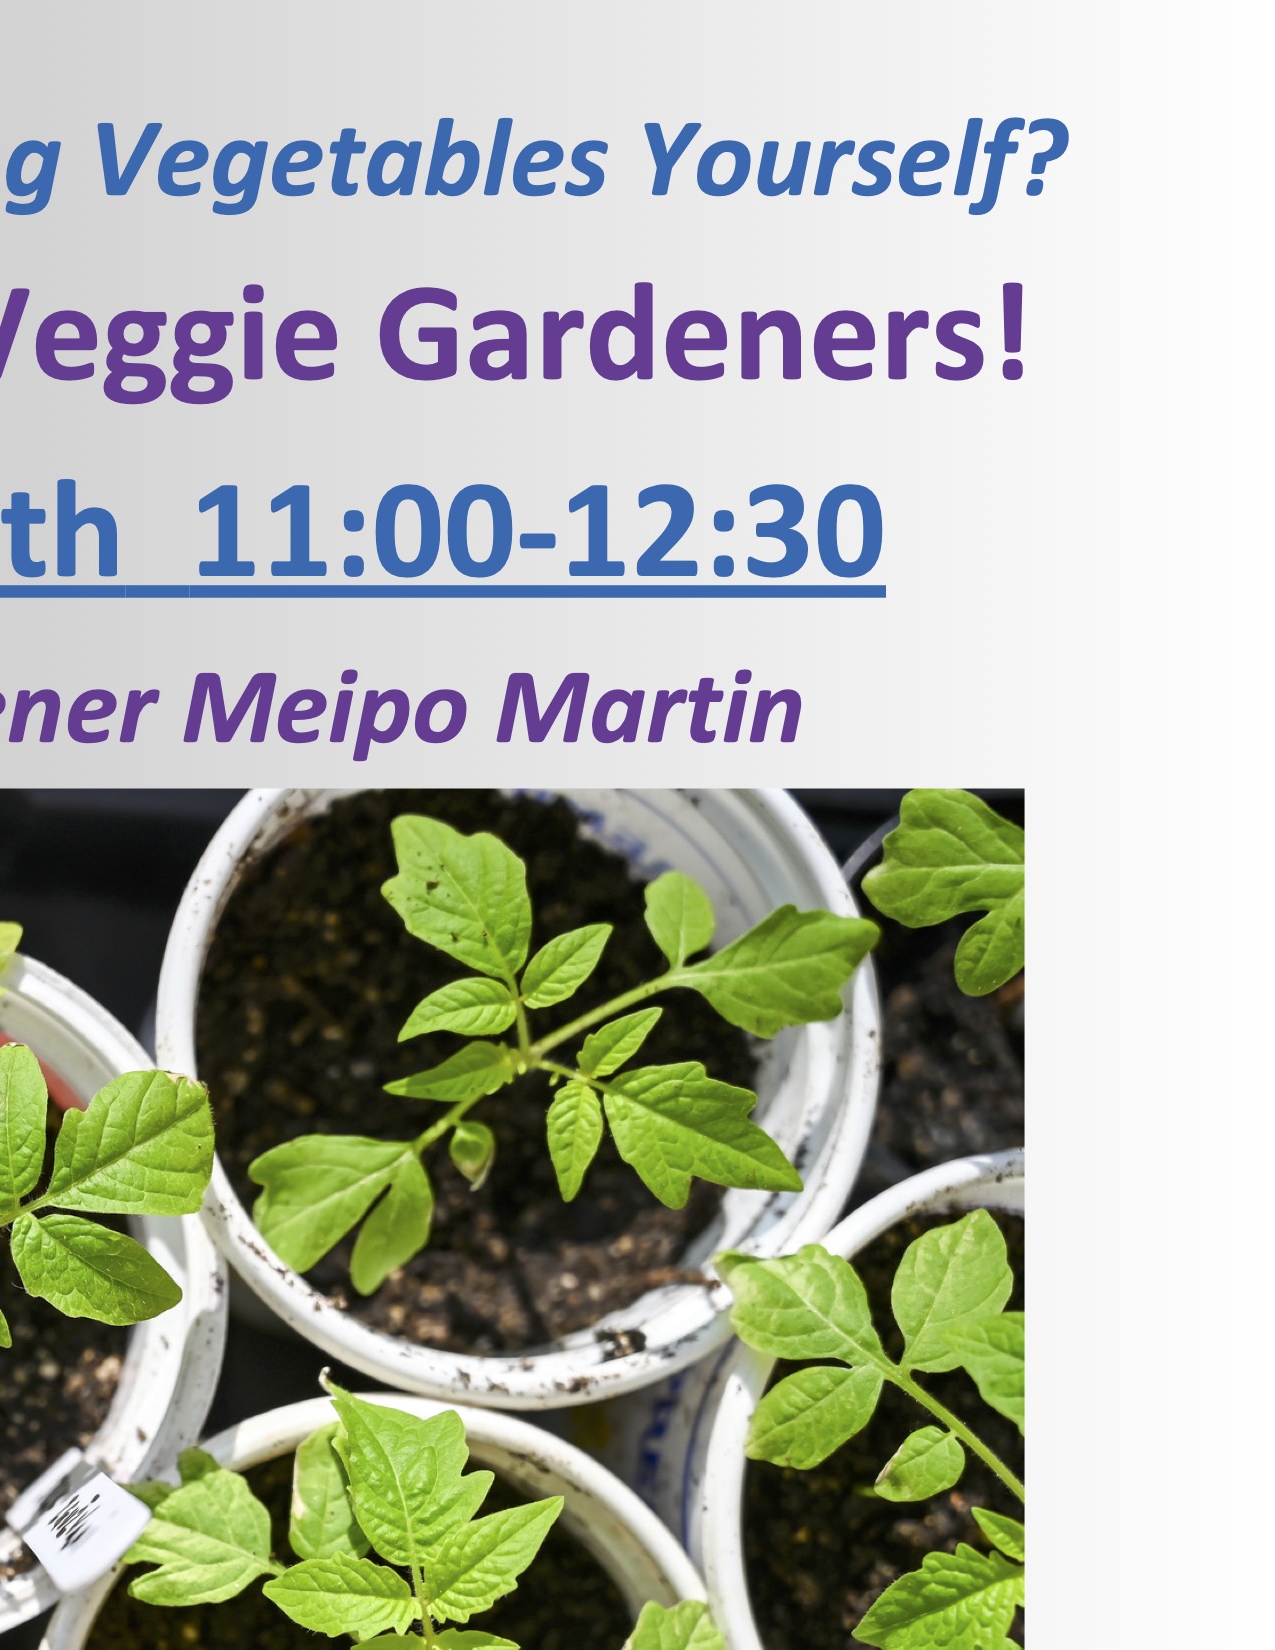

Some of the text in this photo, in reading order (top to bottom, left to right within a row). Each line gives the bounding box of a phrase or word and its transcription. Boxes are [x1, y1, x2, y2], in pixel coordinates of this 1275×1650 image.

[98, 118, 608, 215] Vegetables
[644, 117, 1069, 215] Yourself?
[380, 282, 1023, 381] Gardeners!
[199, 484, 882, 578] 11:00-12:30
[184, 669, 467, 761] Meipo
[496, 669, 801, 743] Martin
